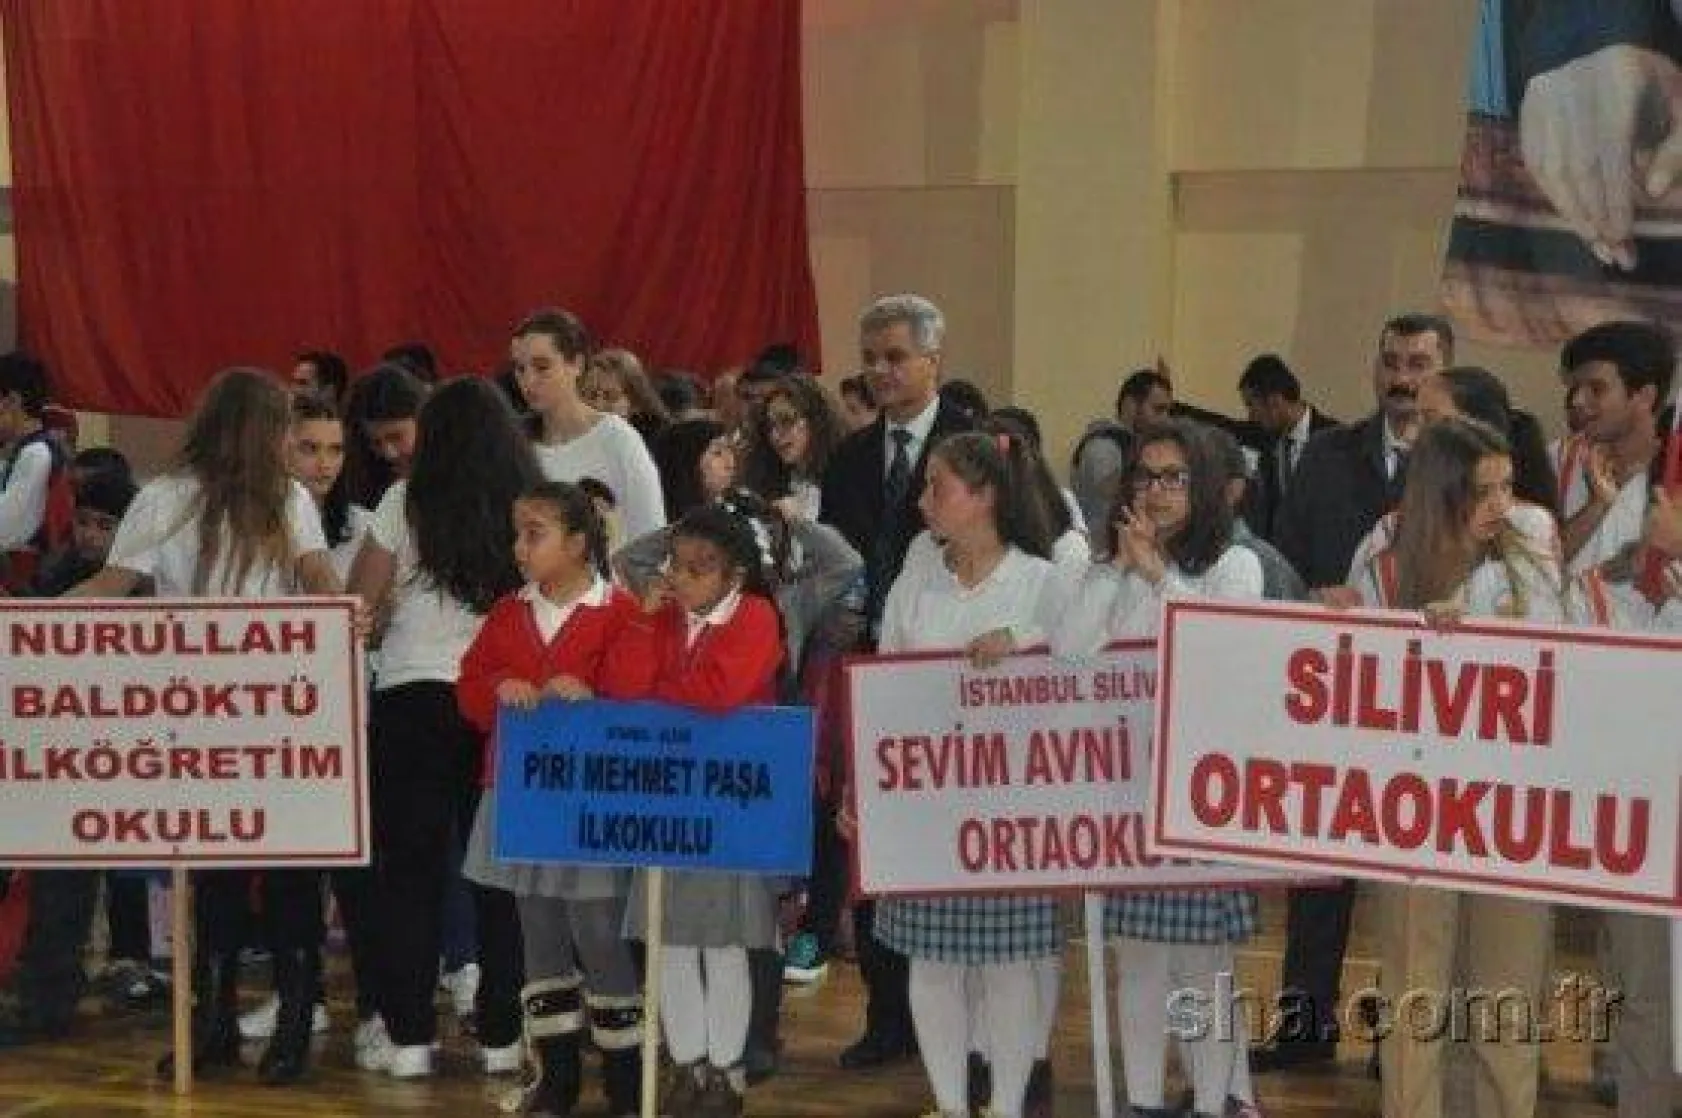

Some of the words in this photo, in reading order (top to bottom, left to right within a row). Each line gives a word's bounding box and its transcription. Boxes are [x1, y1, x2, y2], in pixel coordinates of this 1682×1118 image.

[11, 620, 317, 656] NURULLAH
[12, 676, 319, 718] BALDÖKTÜ
[959, 674, 1083, 706] İSTANBUL
[1284, 633, 1556, 746] SİLİVRİ
[0, 737, 342, 779] İLKÖĞRETİM
[523, 746, 576, 791] PİRİ
[584, 754, 696, 796] MEHMET
[702, 761, 772, 809] PAŞA
[876, 724, 1010, 790] SEVİM
[1025, 715, 1132, 785] AVNİ
[71, 809, 265, 843] OKULU
[578, 803, 713, 856] İLKOKULU
[1190, 752, 1650, 875] ORTAOKULU
[957, 812, 1220, 873] ORTAOKU
